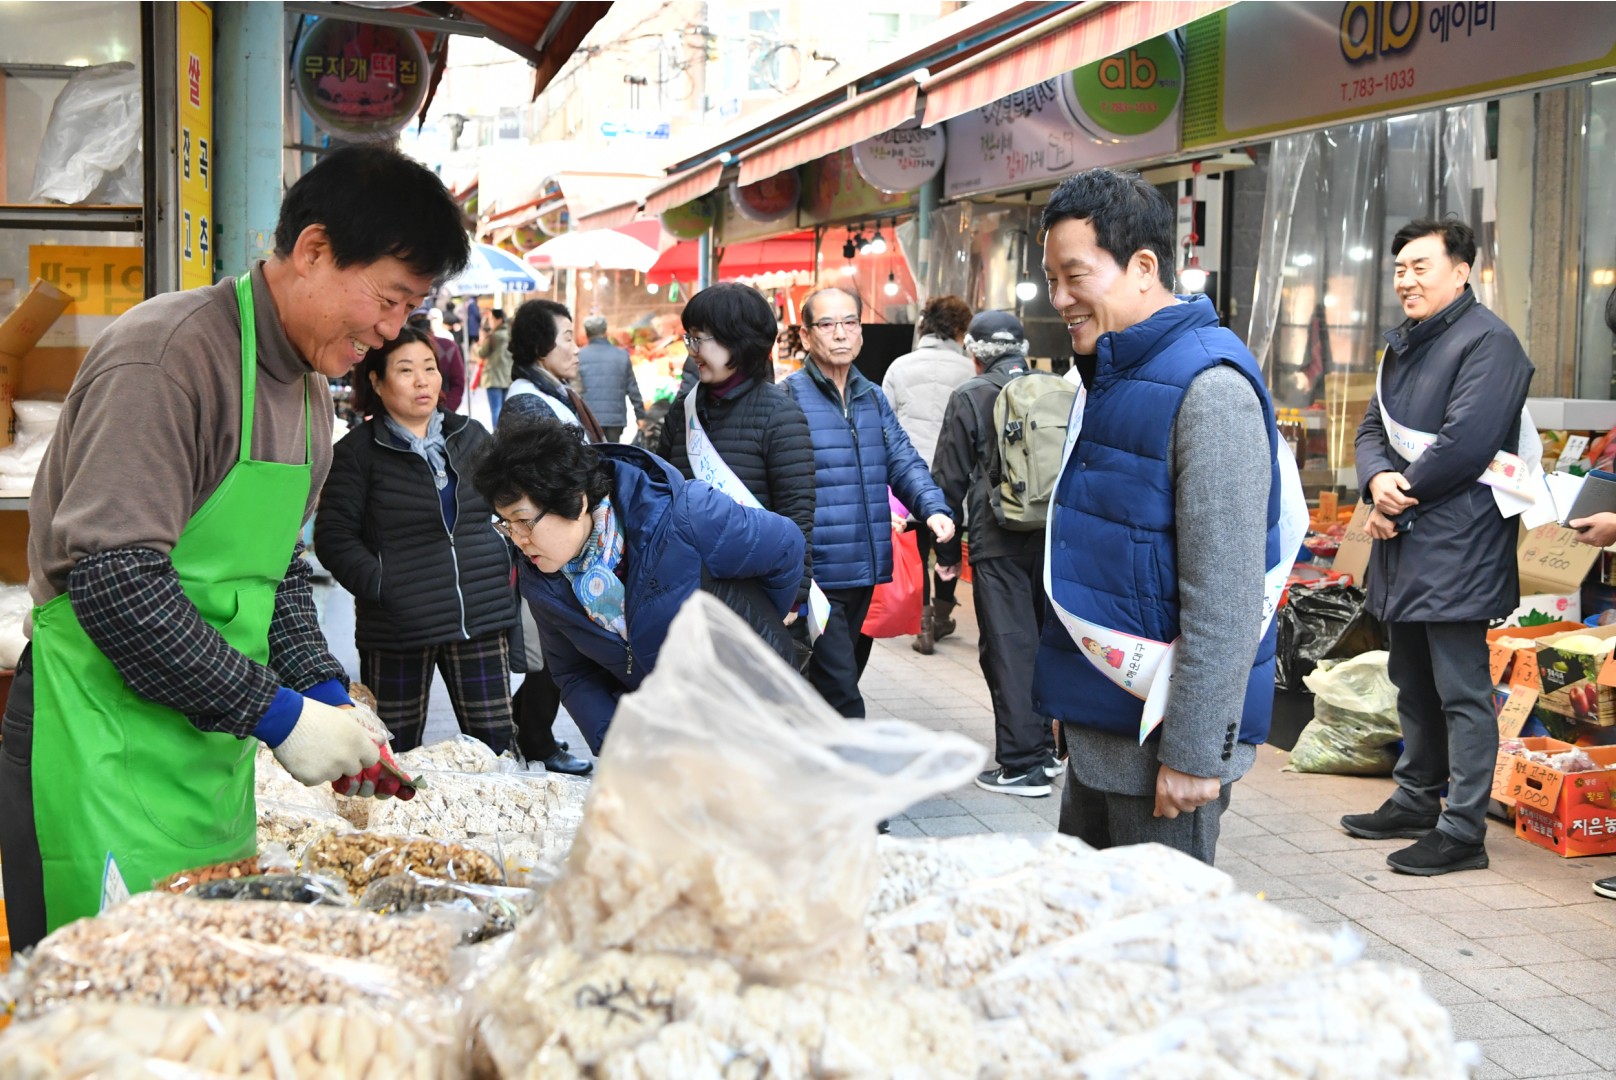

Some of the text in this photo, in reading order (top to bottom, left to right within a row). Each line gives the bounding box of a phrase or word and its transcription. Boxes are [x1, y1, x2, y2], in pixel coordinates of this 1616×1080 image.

[1340, 0, 1422, 65] ab
[1429, 1, 1496, 43] 에이비
[188, 54, 201, 108] 쌀
[304, 53, 417, 87] 무지개떡집
[1098, 48, 1157, 90] ab
[1126, 643, 1146, 679] 해운대구
[1530, 766, 1558, 786] 고구마
[1514, 785, 1549, 807] 3.000
